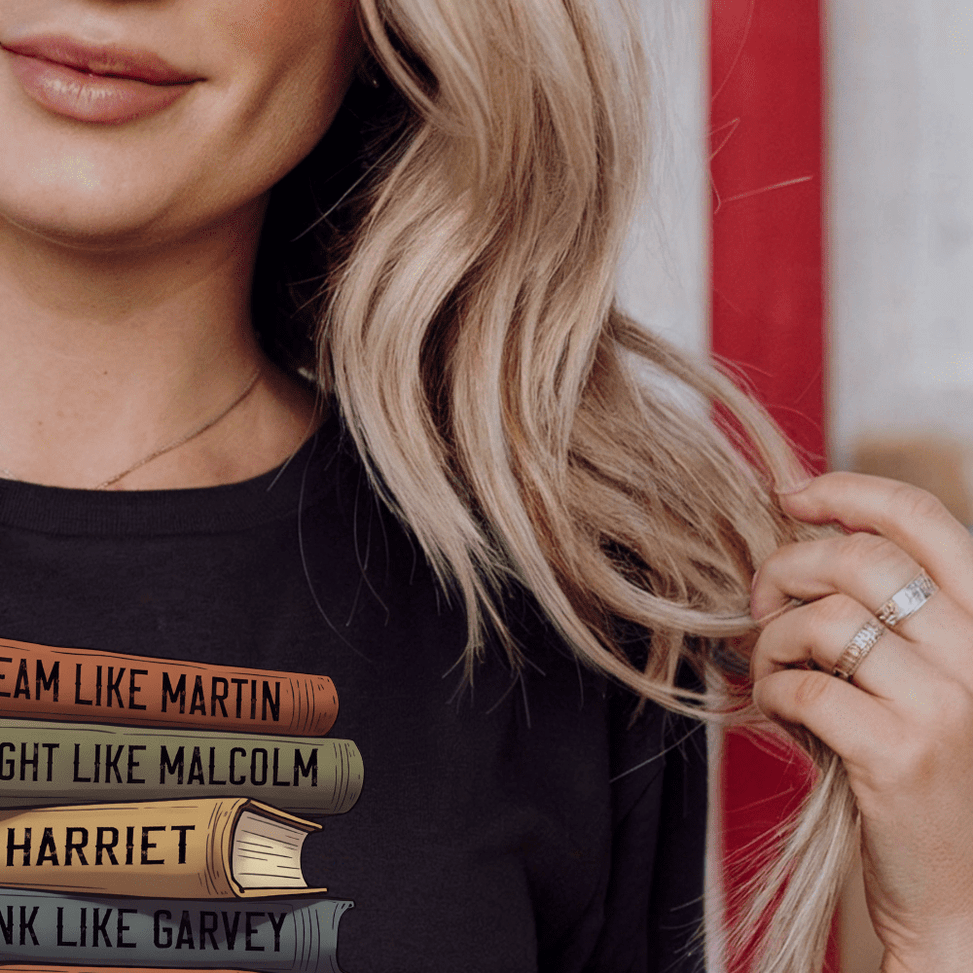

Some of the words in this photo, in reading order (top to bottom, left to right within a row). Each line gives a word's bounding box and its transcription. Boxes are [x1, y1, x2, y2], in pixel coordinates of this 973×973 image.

[74, 661, 149, 712] LIKE
[161, 671, 282, 722] MARTIN
[73, 744, 146, 784] LIKE
[159, 746, 320, 788] MALCOLM
[5, 825, 195, 867] HARRIET
[56, 907, 137, 949] LIKE
[153, 908, 287, 952] GARVEY
